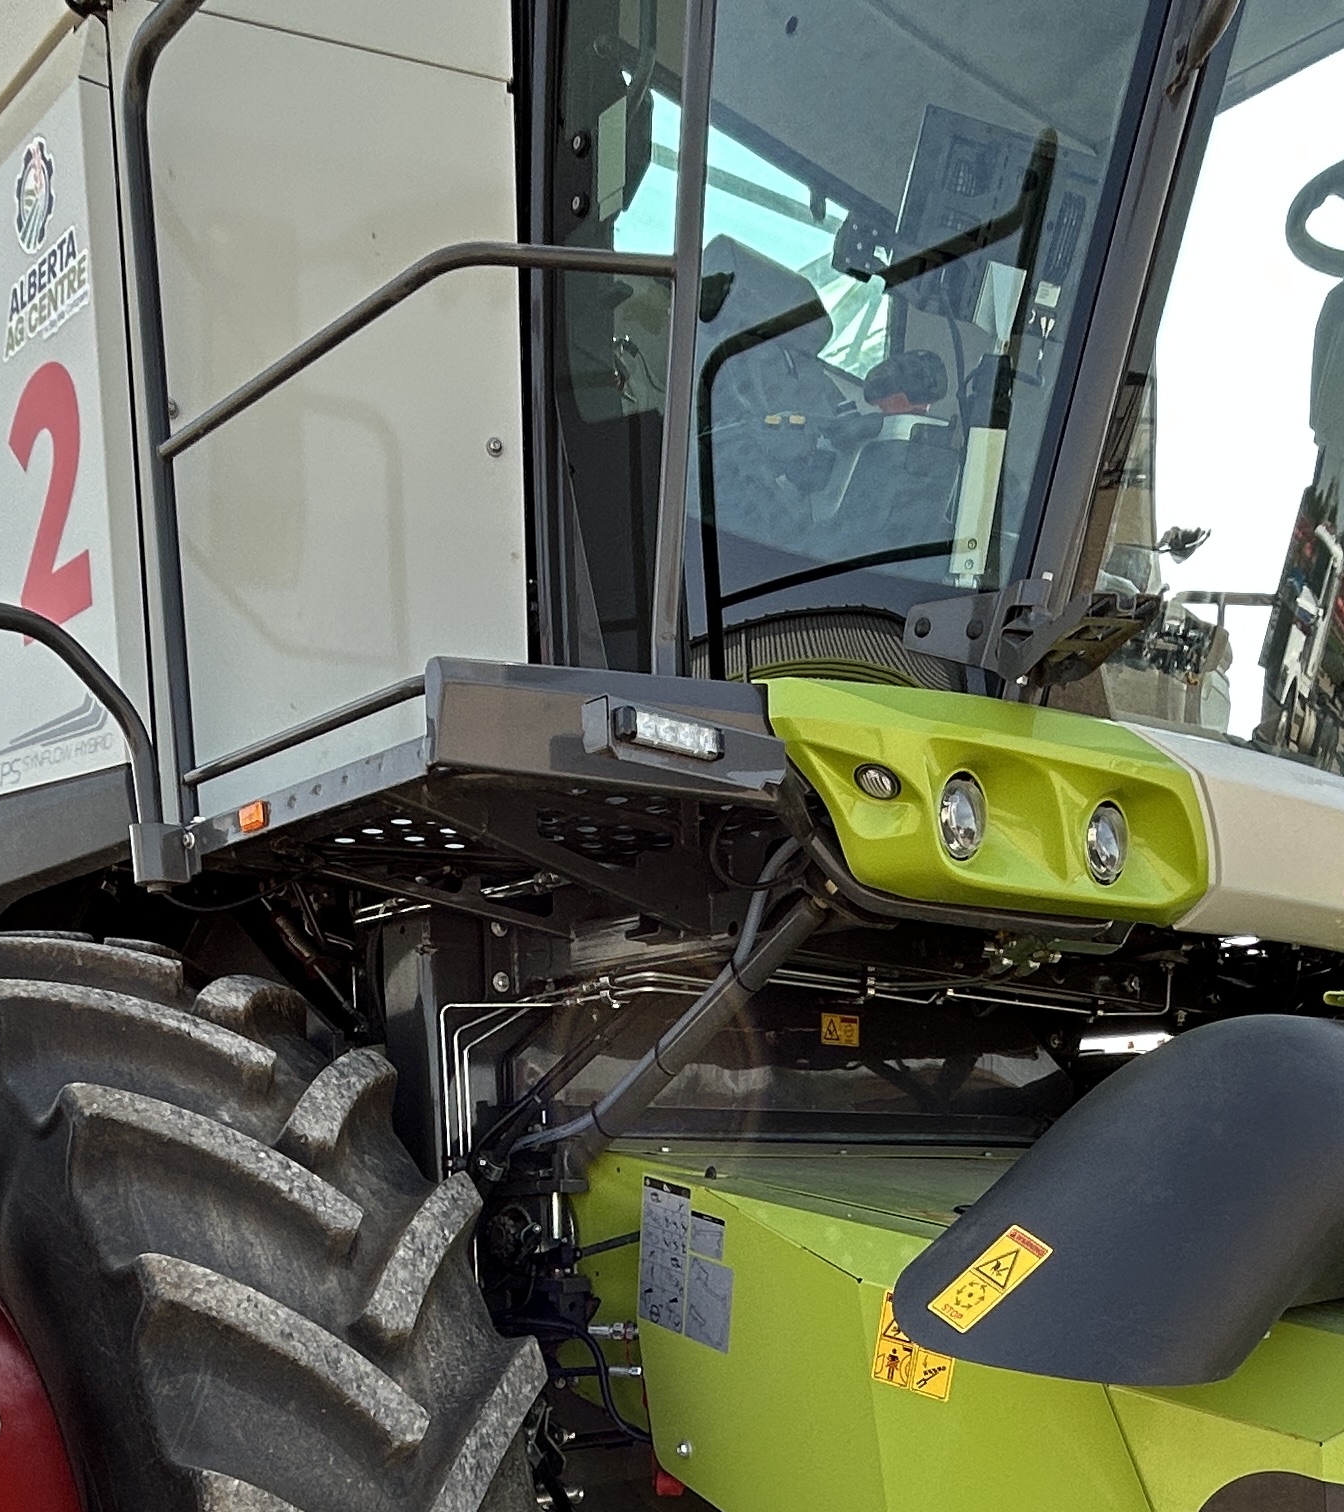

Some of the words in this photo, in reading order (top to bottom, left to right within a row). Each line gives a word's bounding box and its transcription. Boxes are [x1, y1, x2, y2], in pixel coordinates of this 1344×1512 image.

[4, 315, 25, 359] AG
[27, 253, 87, 334] CENTRE
[8, 229, 77, 323] ALBERTA
[8, 361, 93, 648] 2
[940, 1303, 964, 1320] STOP
